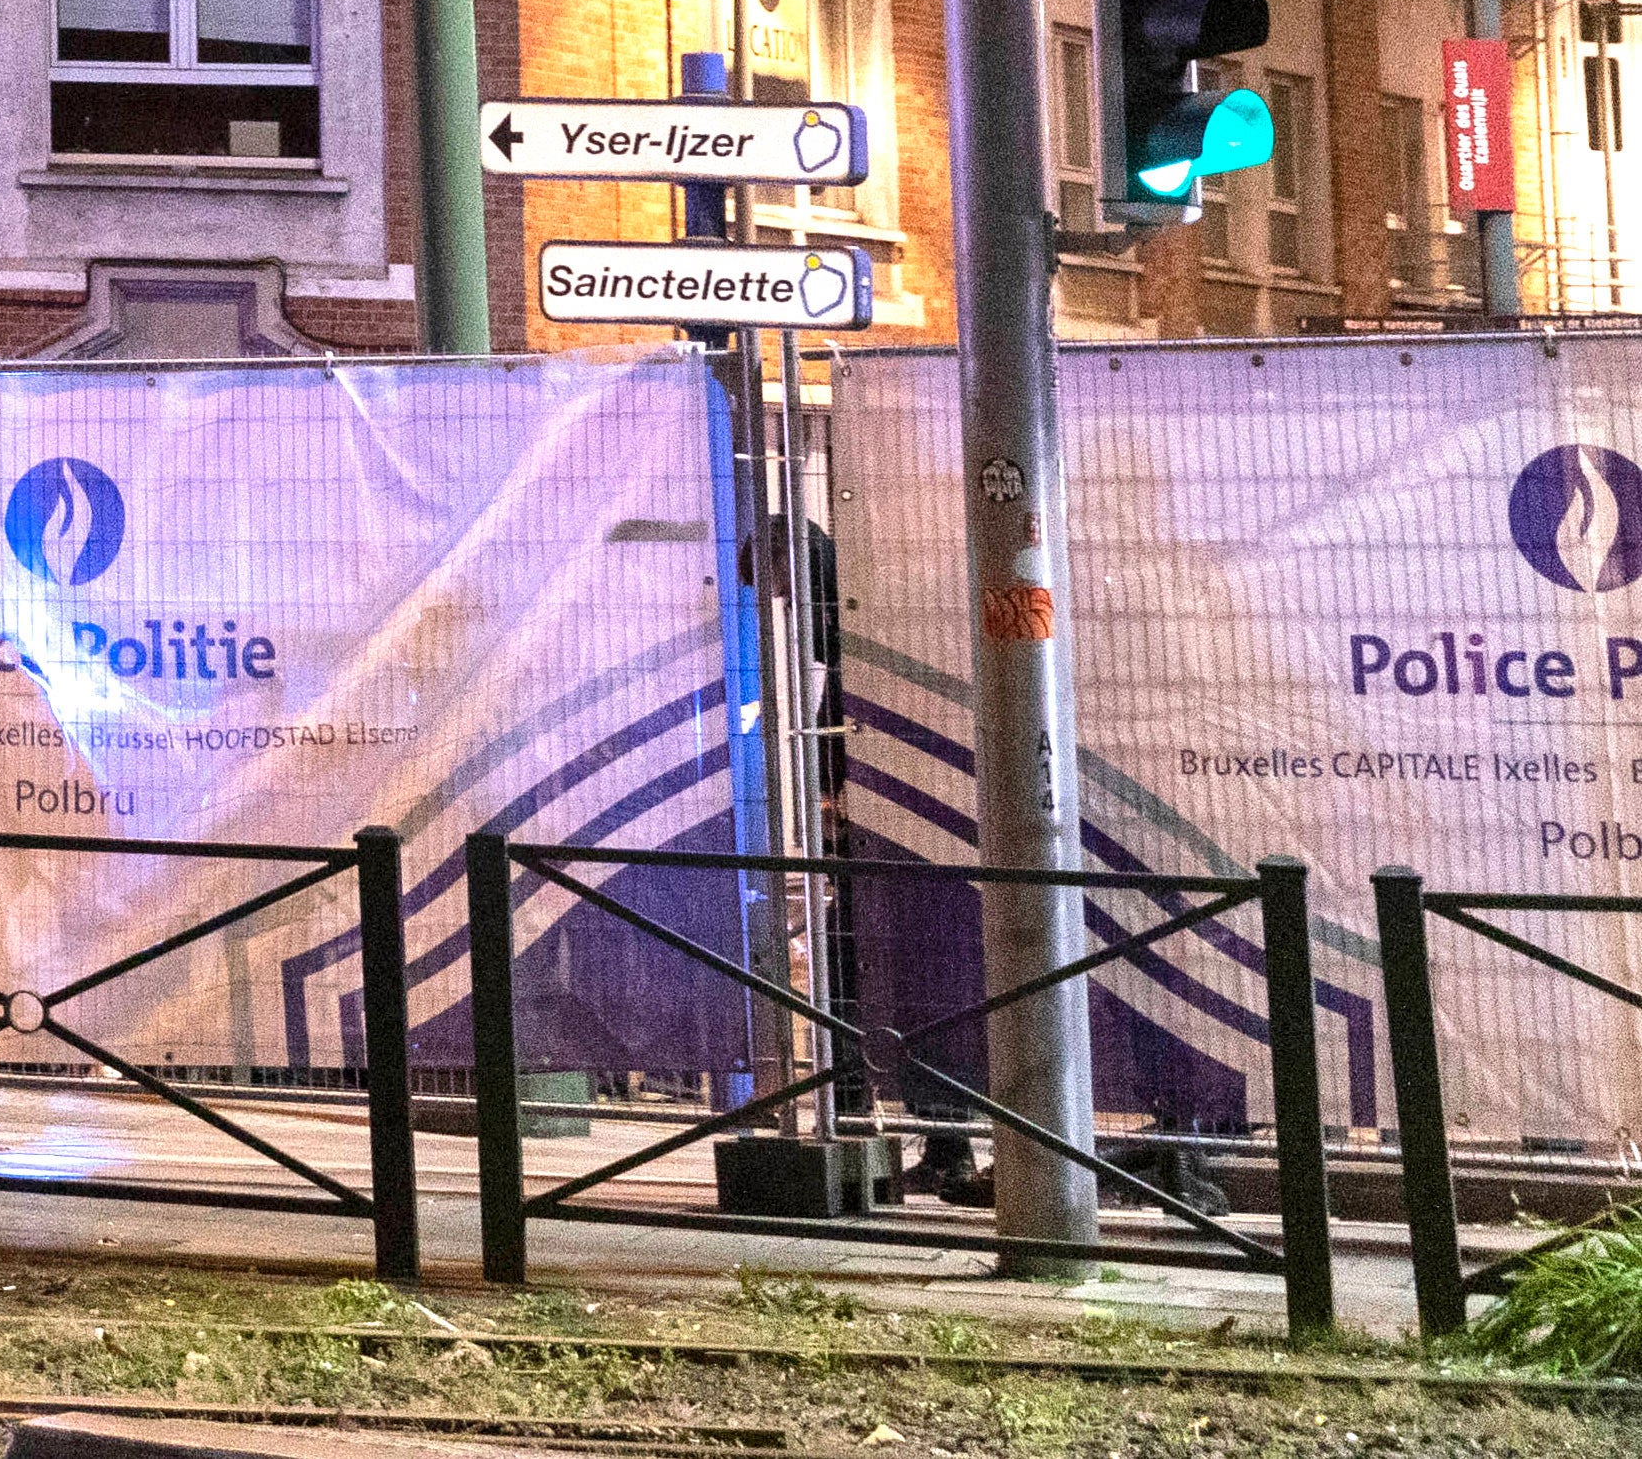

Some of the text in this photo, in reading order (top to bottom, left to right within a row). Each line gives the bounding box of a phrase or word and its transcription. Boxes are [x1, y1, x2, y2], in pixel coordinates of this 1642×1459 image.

[560, 123, 755, 164] Yser-Ijzer
[546, 264, 795, 303] Sainctelette
[71, 619, 276, 680] Politie
[1350, 631, 1576, 699] Police
[1180, 748, 1324, 778] Bruxelles
[1332, 750, 1481, 781] CAPITALE
[1493, 752, 1599, 783] Ixelles
[15, 778, 135, 817] Polbru
[1539, 819, 1642, 862] Polb
